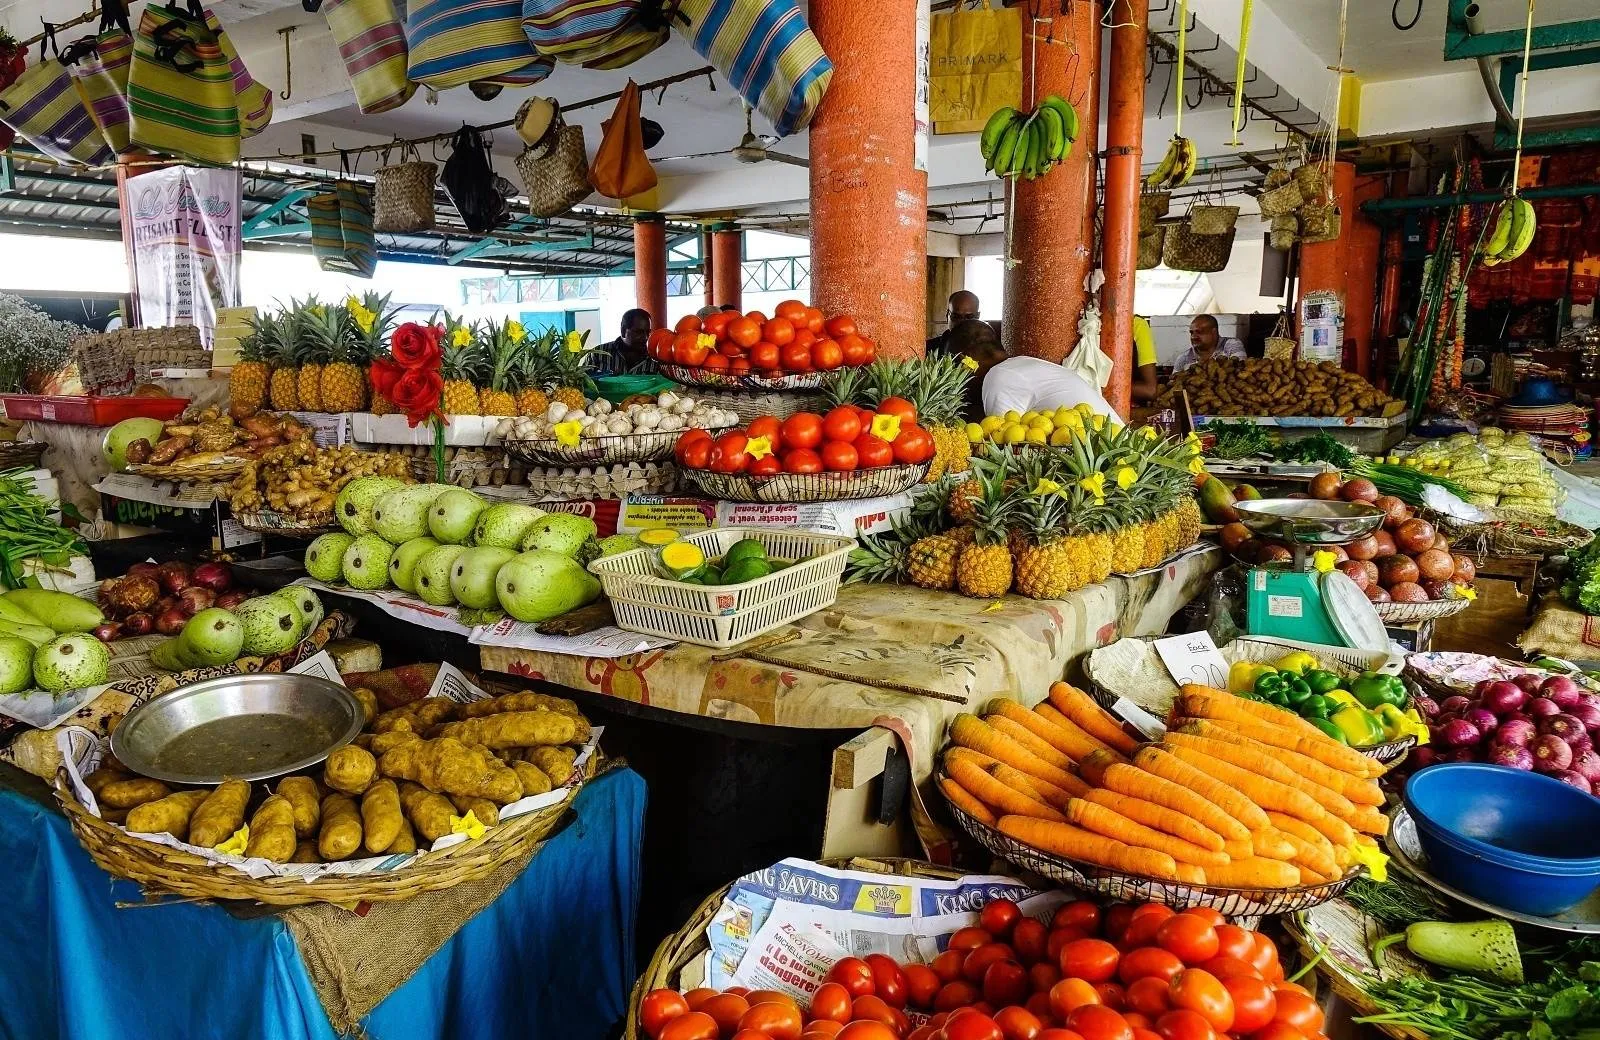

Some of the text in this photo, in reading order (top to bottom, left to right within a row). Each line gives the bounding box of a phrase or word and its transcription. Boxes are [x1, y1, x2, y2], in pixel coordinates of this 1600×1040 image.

[938, 53, 1008, 67] PRIMARK
[734, 504, 798, 514] scalp d'Arsenal
[728, 515, 798, 524] Leicester veut le
[1187, 642, 1208, 652] Each
[778, 869, 840, 904] SAVERS
[934, 888, 985, 917] KING
[773, 932, 804, 962] MICHELLE
[773, 946, 788, 965] Le
